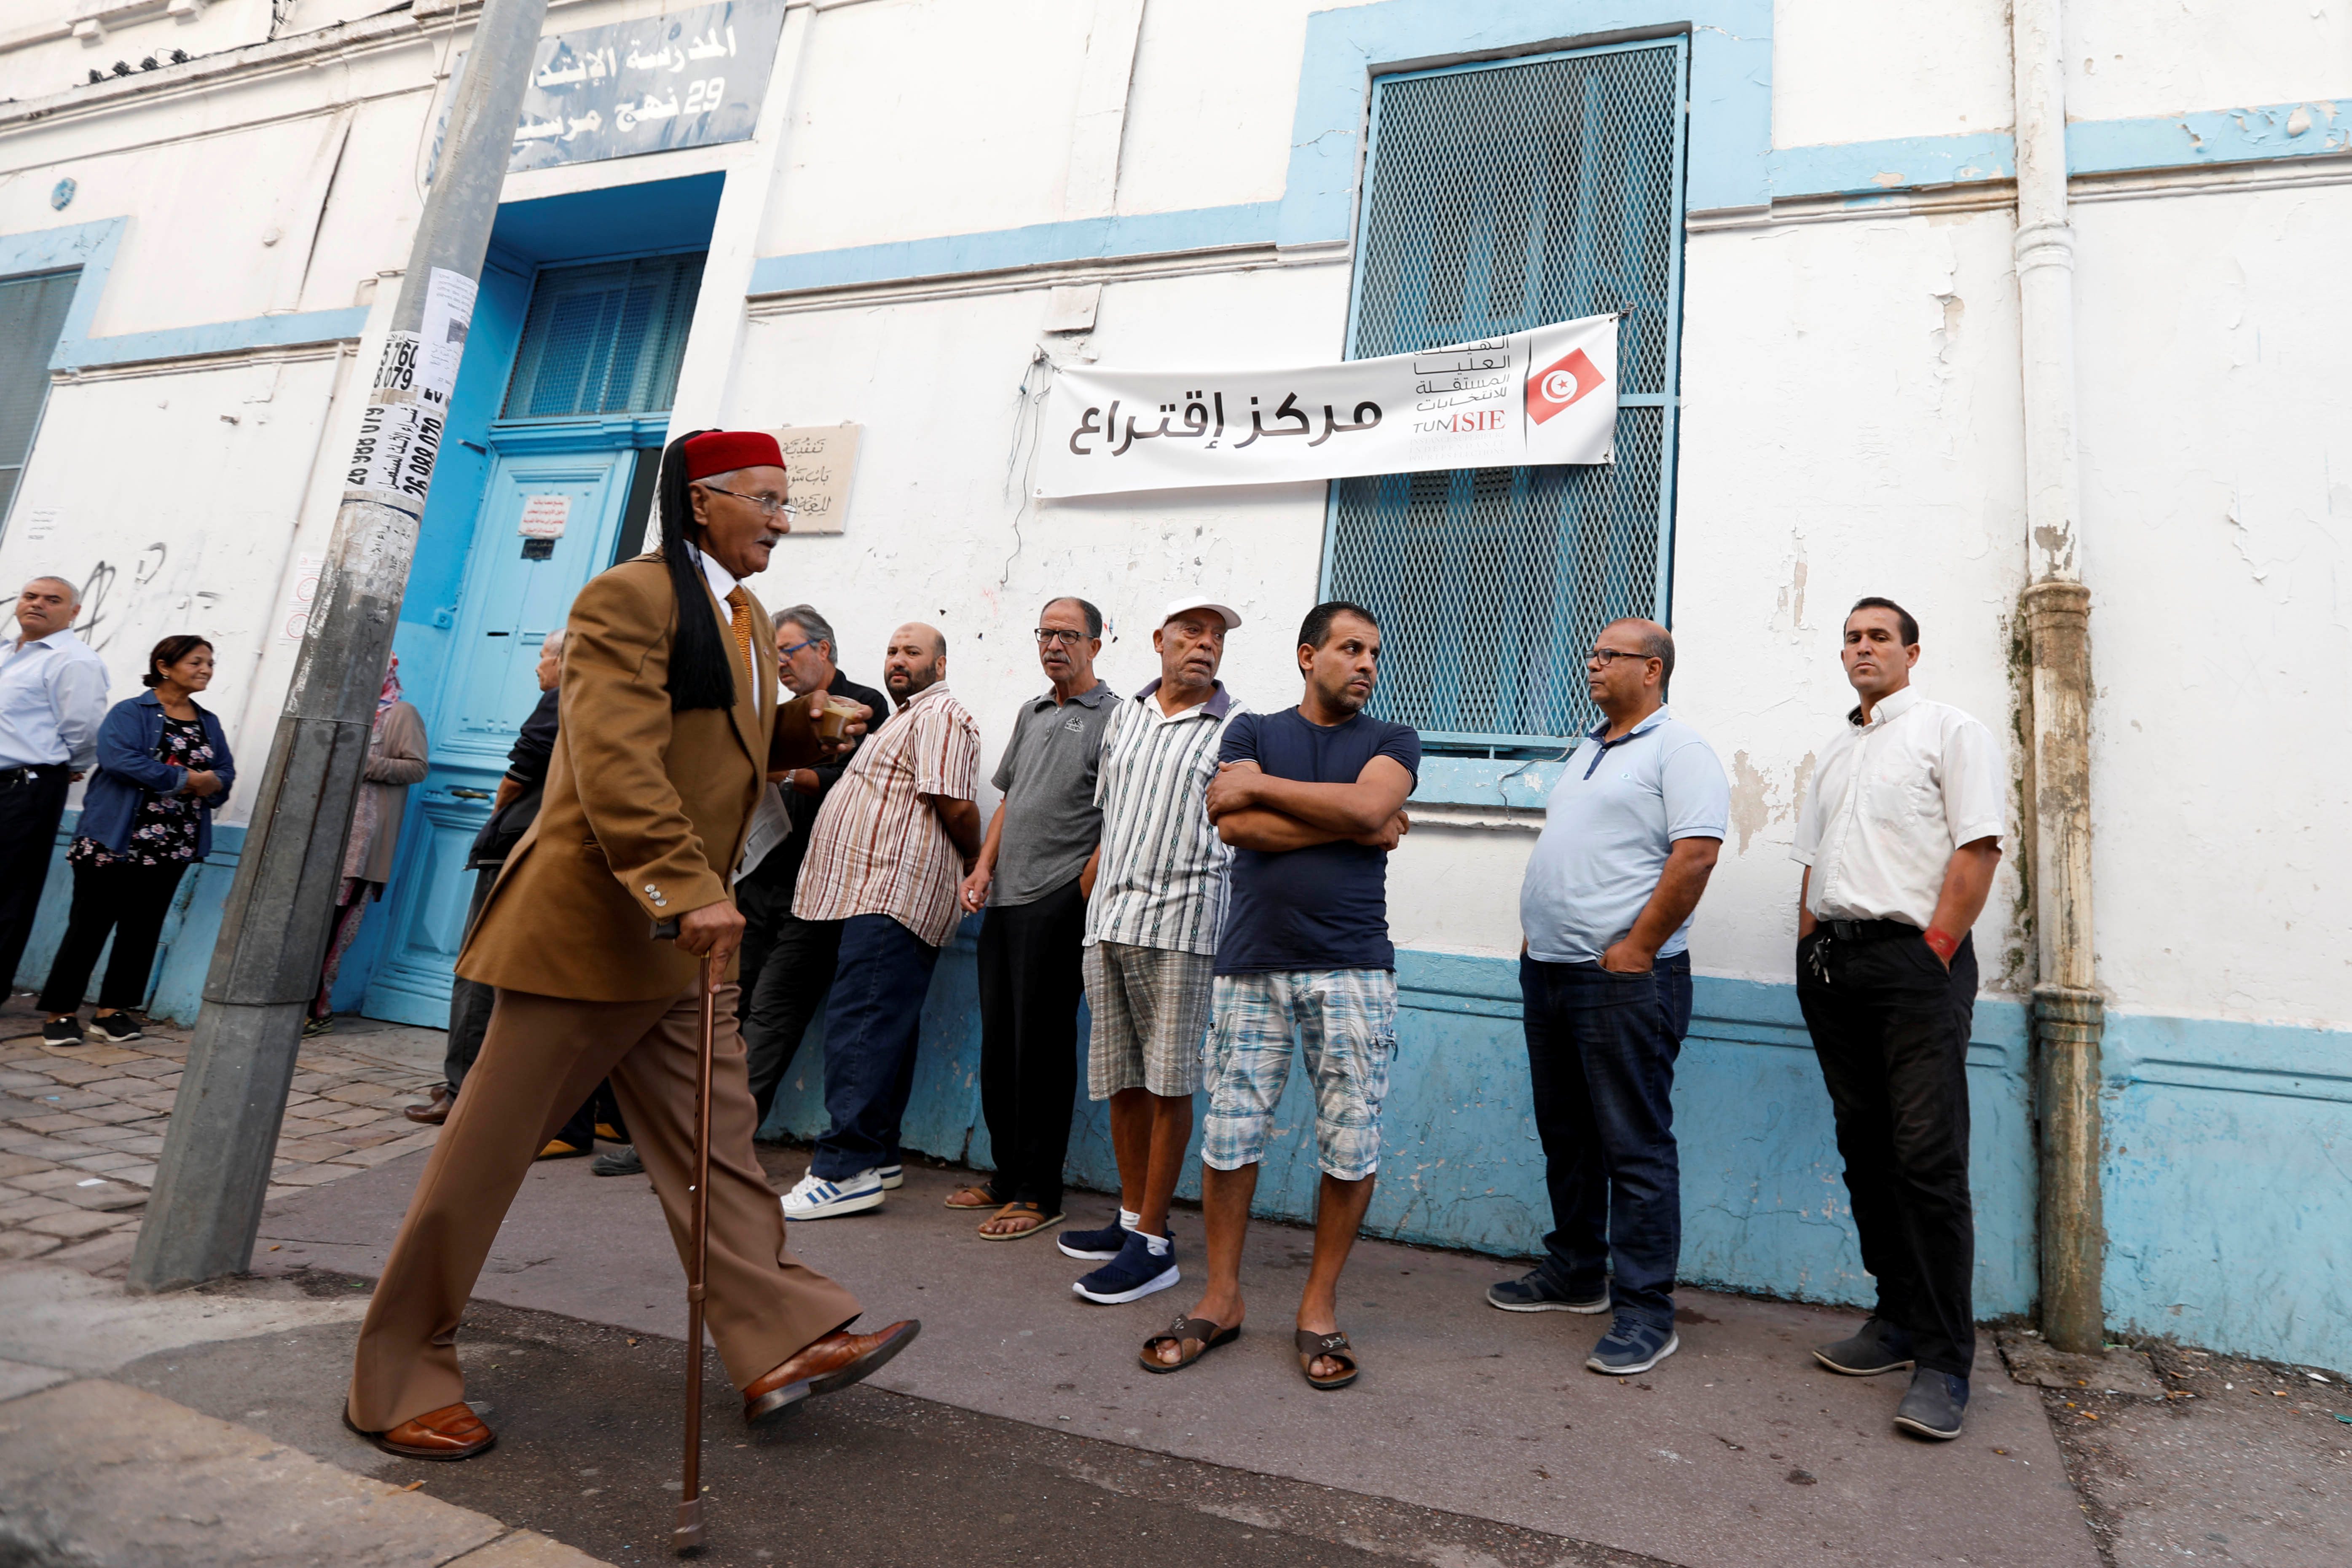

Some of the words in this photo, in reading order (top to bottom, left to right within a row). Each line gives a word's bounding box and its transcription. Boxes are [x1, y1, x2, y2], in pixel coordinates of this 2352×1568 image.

[626, 25, 736, 73] المدرسة
[614, 87, 679, 132] نهج
[683, 76, 726, 115] 29
[1414, 355, 1510, 375] العليا
[1416, 373, 1510, 394] المستقلة
[1416, 386, 1507, 412] للانتخابات
[396, 407, 419, 434] شراء
[1069, 390, 1225, 457] إقتراع
[1234, 391, 1383, 449] مركز
[805, 466, 832, 485] باب
